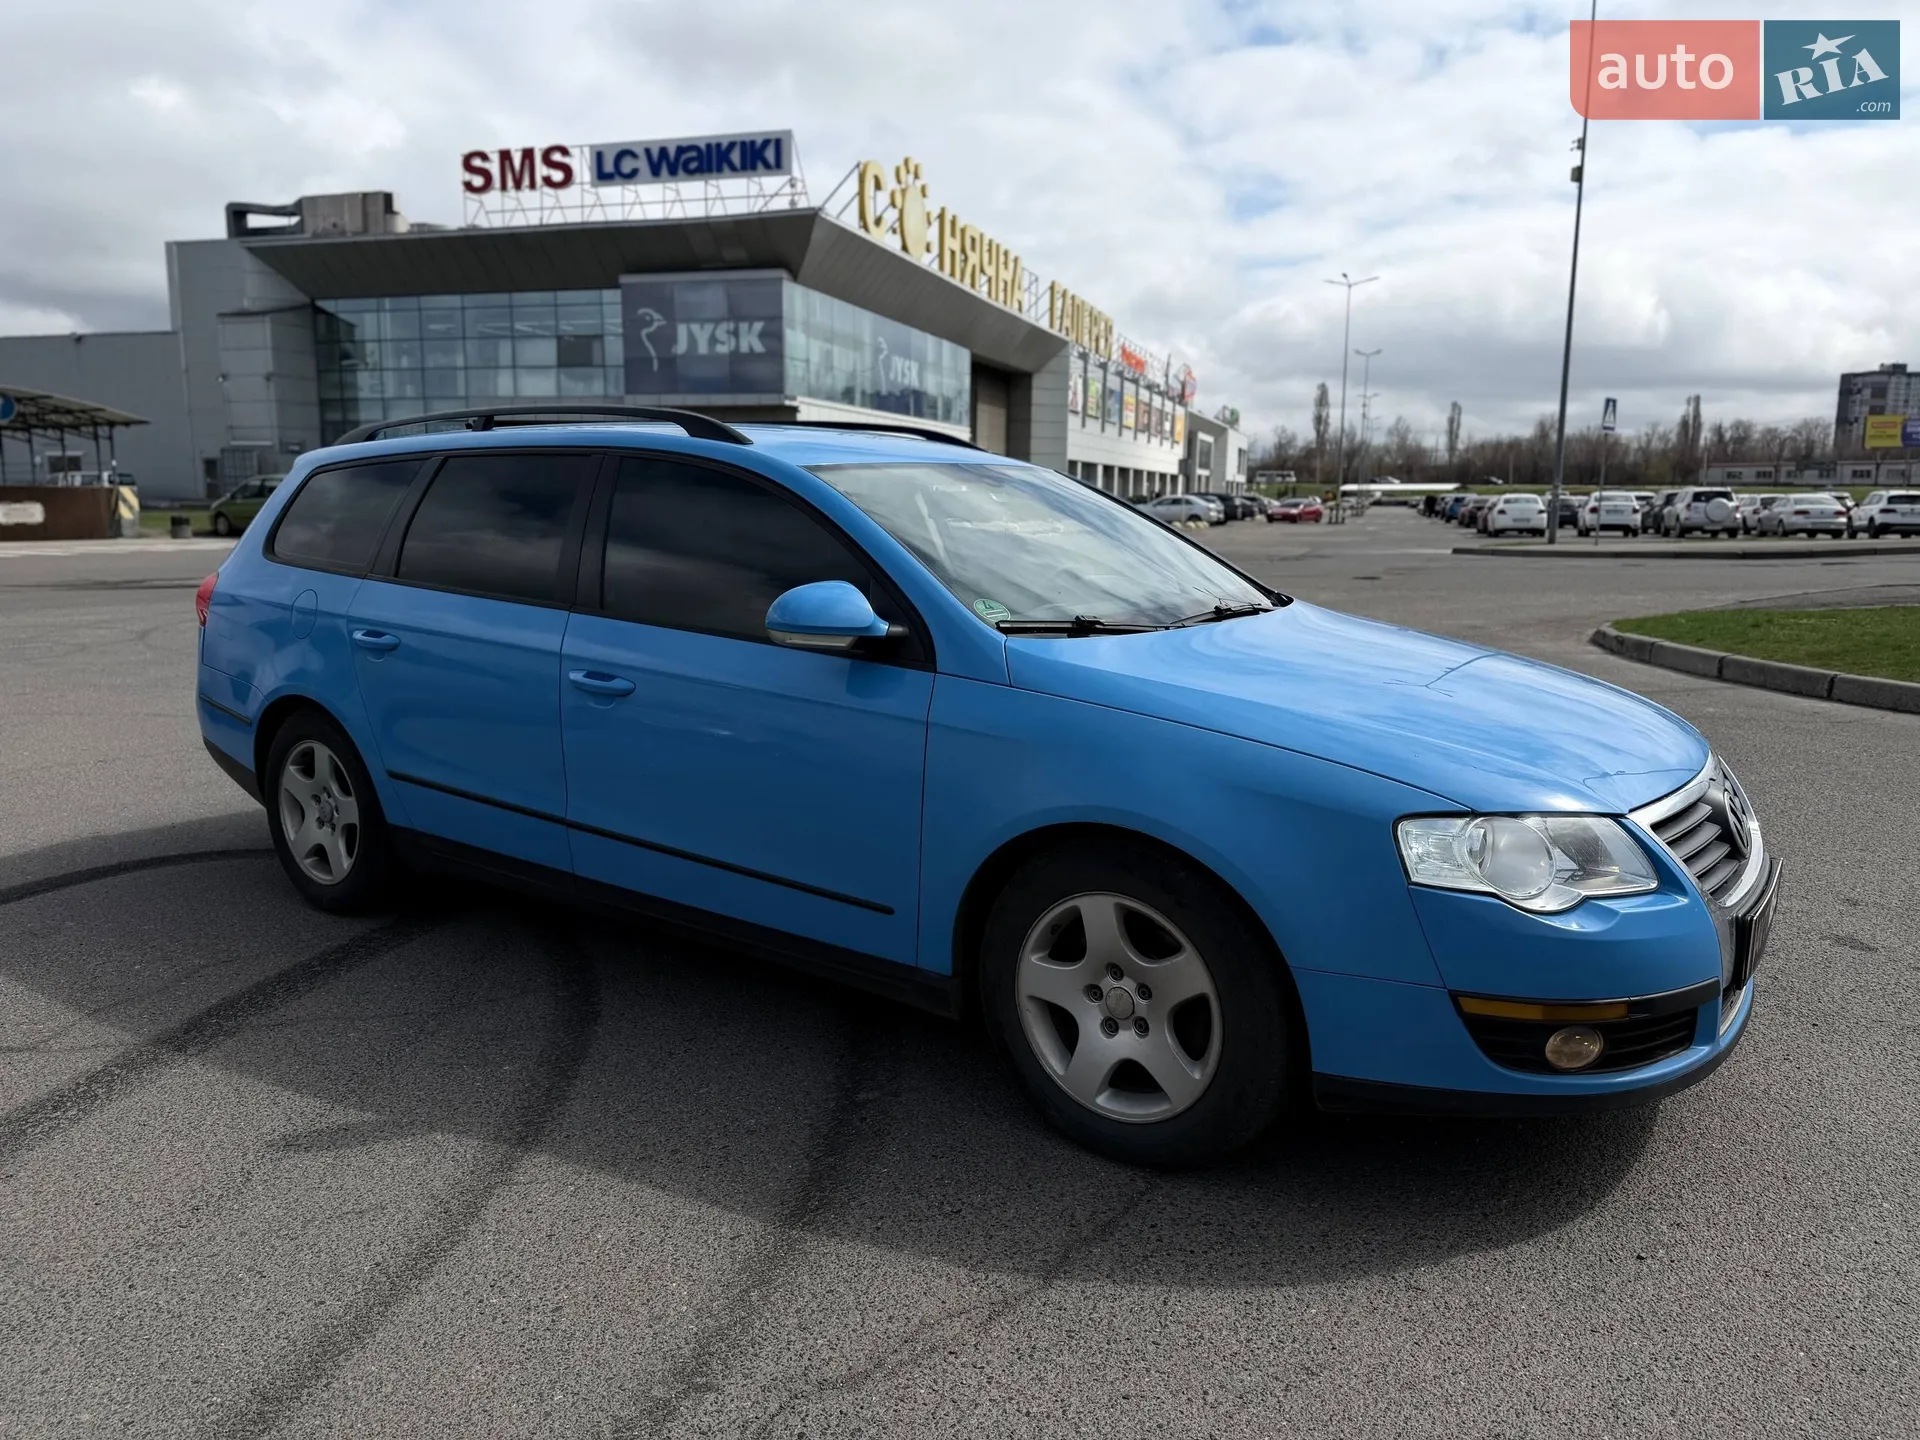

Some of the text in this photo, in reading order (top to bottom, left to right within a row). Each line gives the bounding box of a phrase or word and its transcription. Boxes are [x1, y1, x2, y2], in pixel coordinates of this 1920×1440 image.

[462, 144, 574, 194] SMS
[595, 150, 640, 181] LC
[673, 320, 766, 355] JYSK
[889, 354, 920, 388] JYSK
